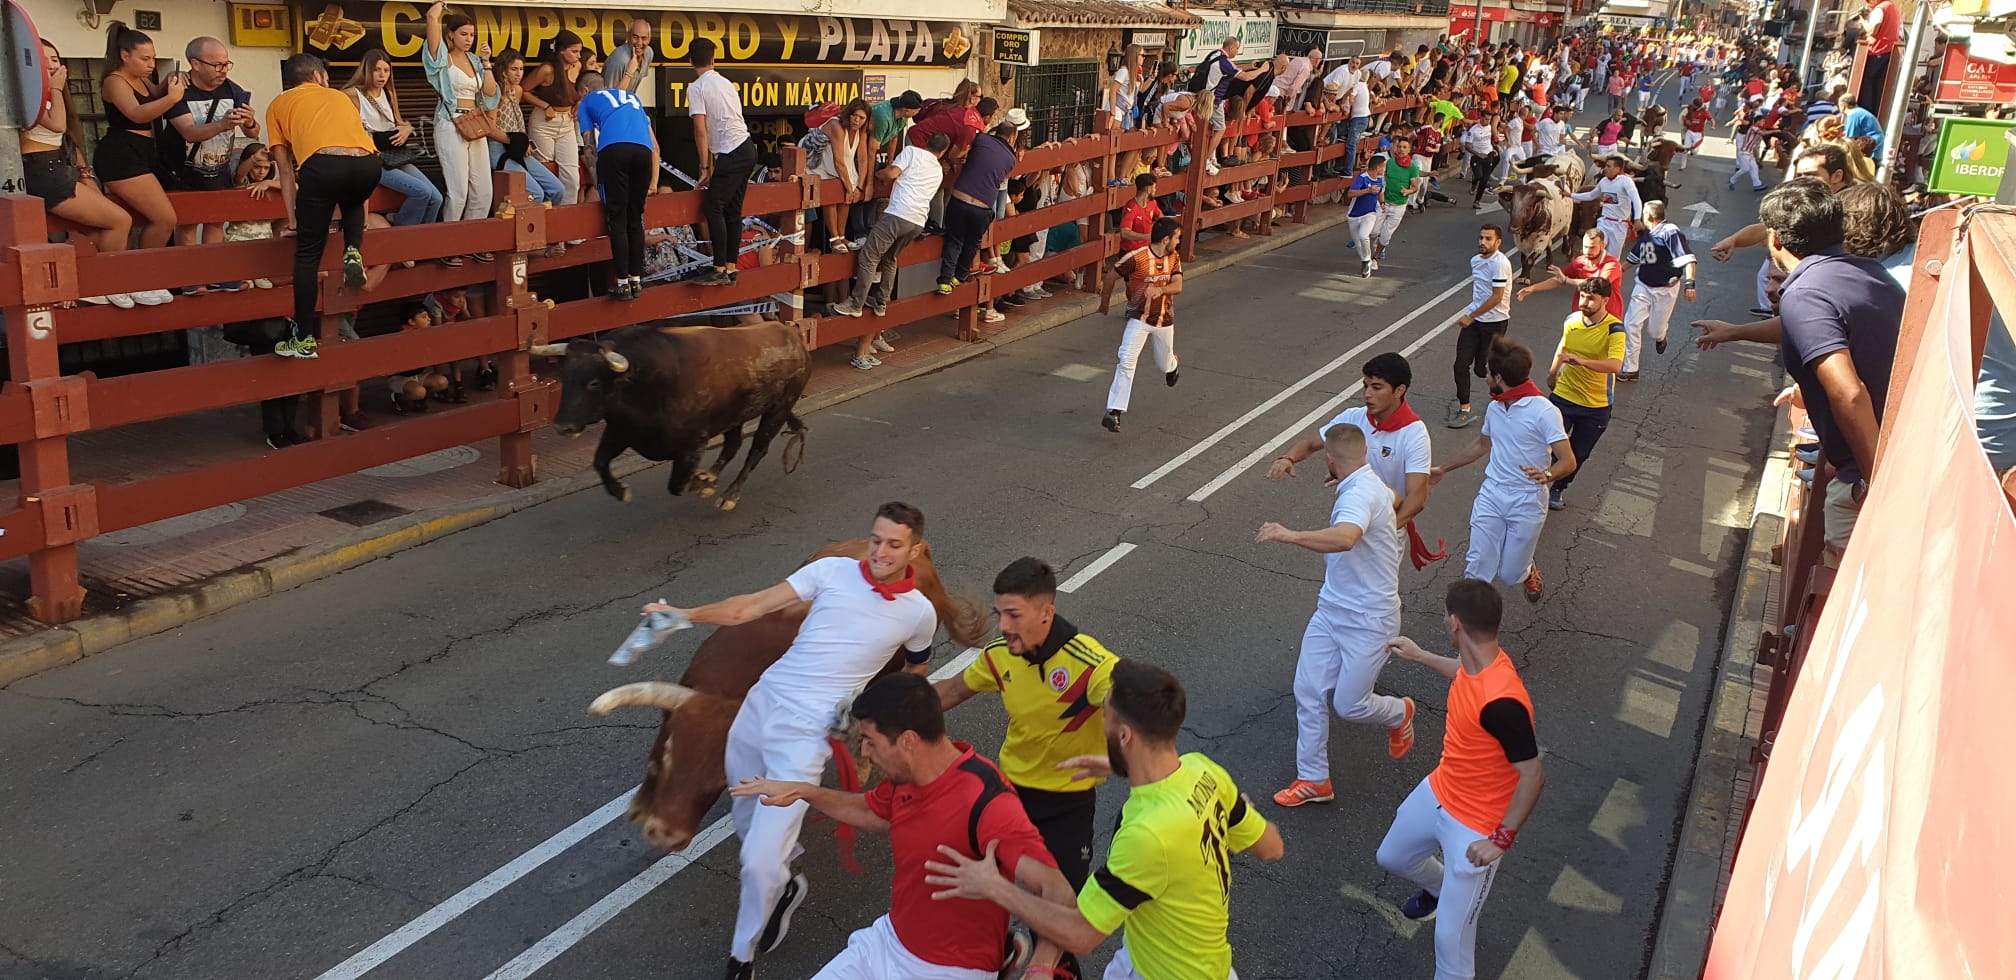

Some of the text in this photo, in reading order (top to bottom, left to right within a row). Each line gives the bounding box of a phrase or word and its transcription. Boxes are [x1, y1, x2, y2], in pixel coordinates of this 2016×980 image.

[660, 12, 760, 60] ORO
[775, 14, 800, 60] Y
[816, 16, 934, 62] PLATA
[996, 32, 1029, 42] COMPRO
[1003, 40, 1020, 48] ORO
[999, 52, 1024, 61] PLATA
[597, 89, 640, 110] 14
[670, 77, 779, 108] TIÓN
[785, 77, 860, 106] MÁXIMA
[1, 178, 25, 192] 40
[1640, 242, 1657, 264] 28
